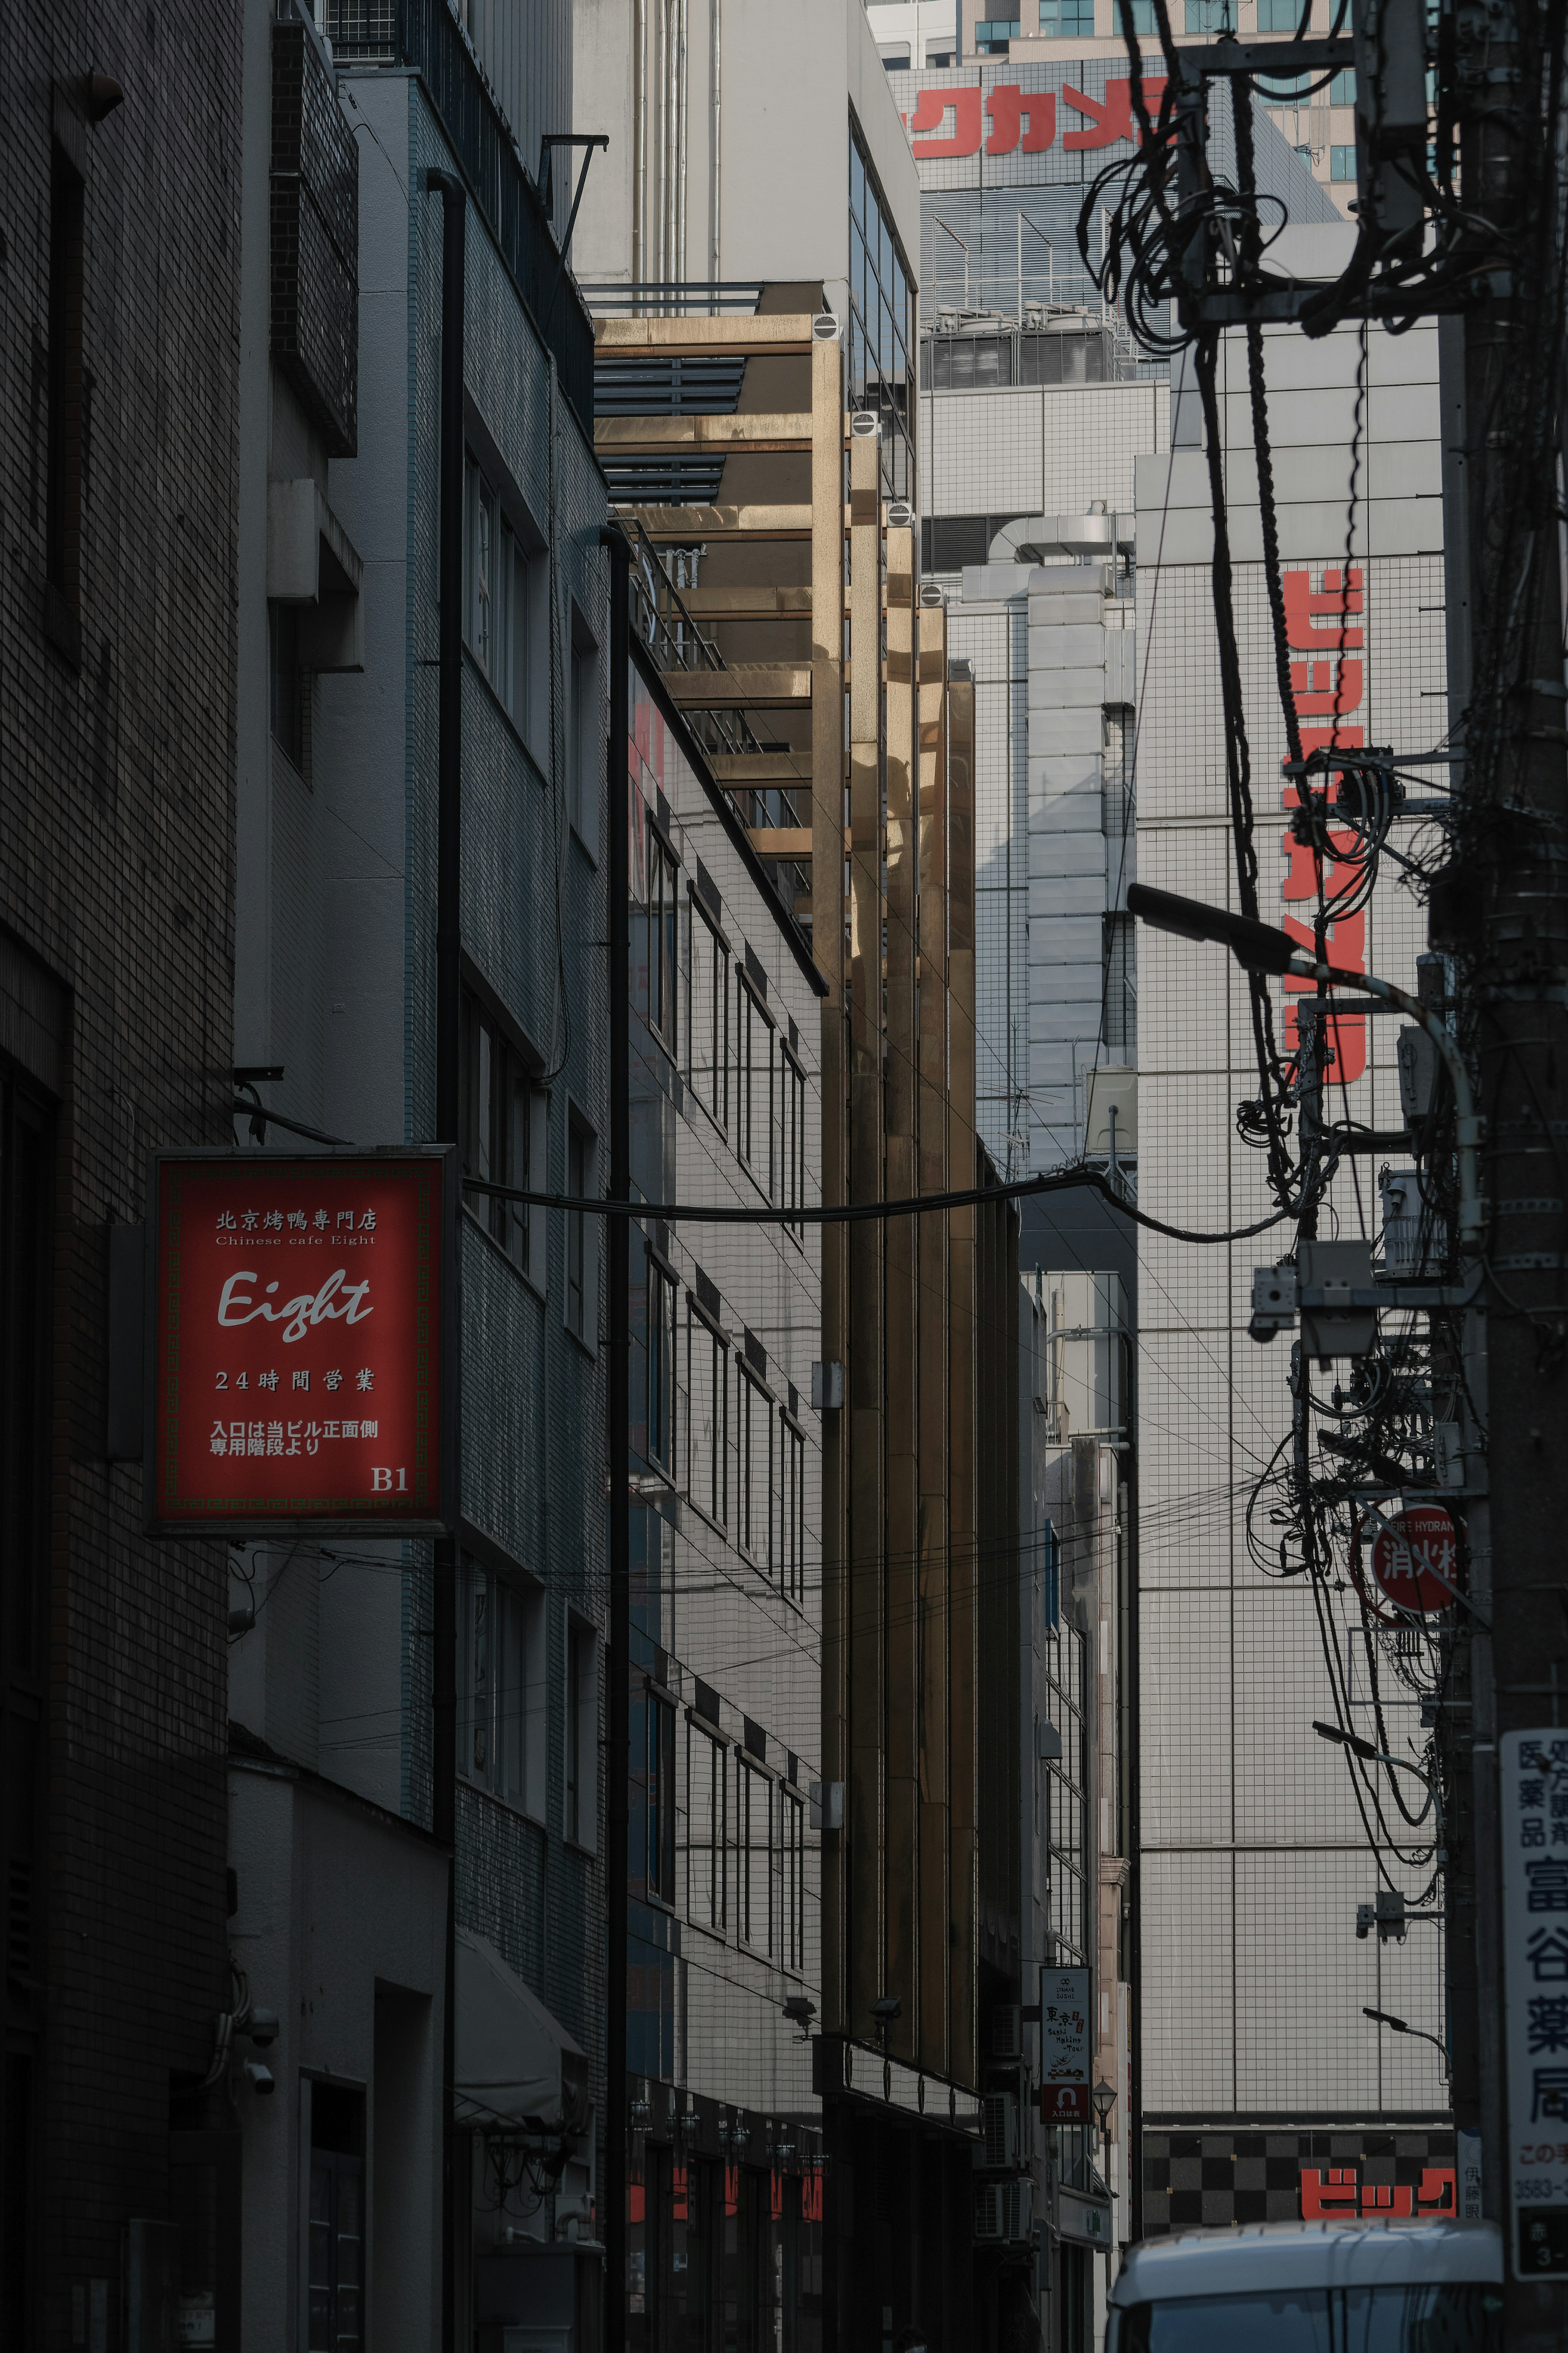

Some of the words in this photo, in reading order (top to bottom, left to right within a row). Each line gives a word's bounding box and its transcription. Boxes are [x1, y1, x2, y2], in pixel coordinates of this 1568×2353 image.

[216, 1236, 282, 1246] Chinese
[289, 1236, 323, 1245] cafe
[331, 1236, 376, 1246] Eight
[217, 1269, 375, 1344] Eight
[215, 1369, 376, 1392] 24時間営業
[209, 1420, 378, 1439] 入口は当ビル正面側
[209, 1439, 320, 1456] 専用階段より
[370, 1467, 409, 1492] B1
[1391, 1521, 1412, 1532] FIRE
[1415, 1521, 1454, 1532] HYDRAN
[1383, 1539, 1470, 1580] 消火栓
[1519, 1740, 1546, 1847] 医薬品
[1526, 1856, 1568, 2124] 富谷薬局
[1046, 2006, 1073, 2027] 東京
[1056, 2036, 1081, 2044] Making
[1301, 2168, 1457, 2220] ビック
[1465, 2167, 1480, 2219] 伊藤眼
